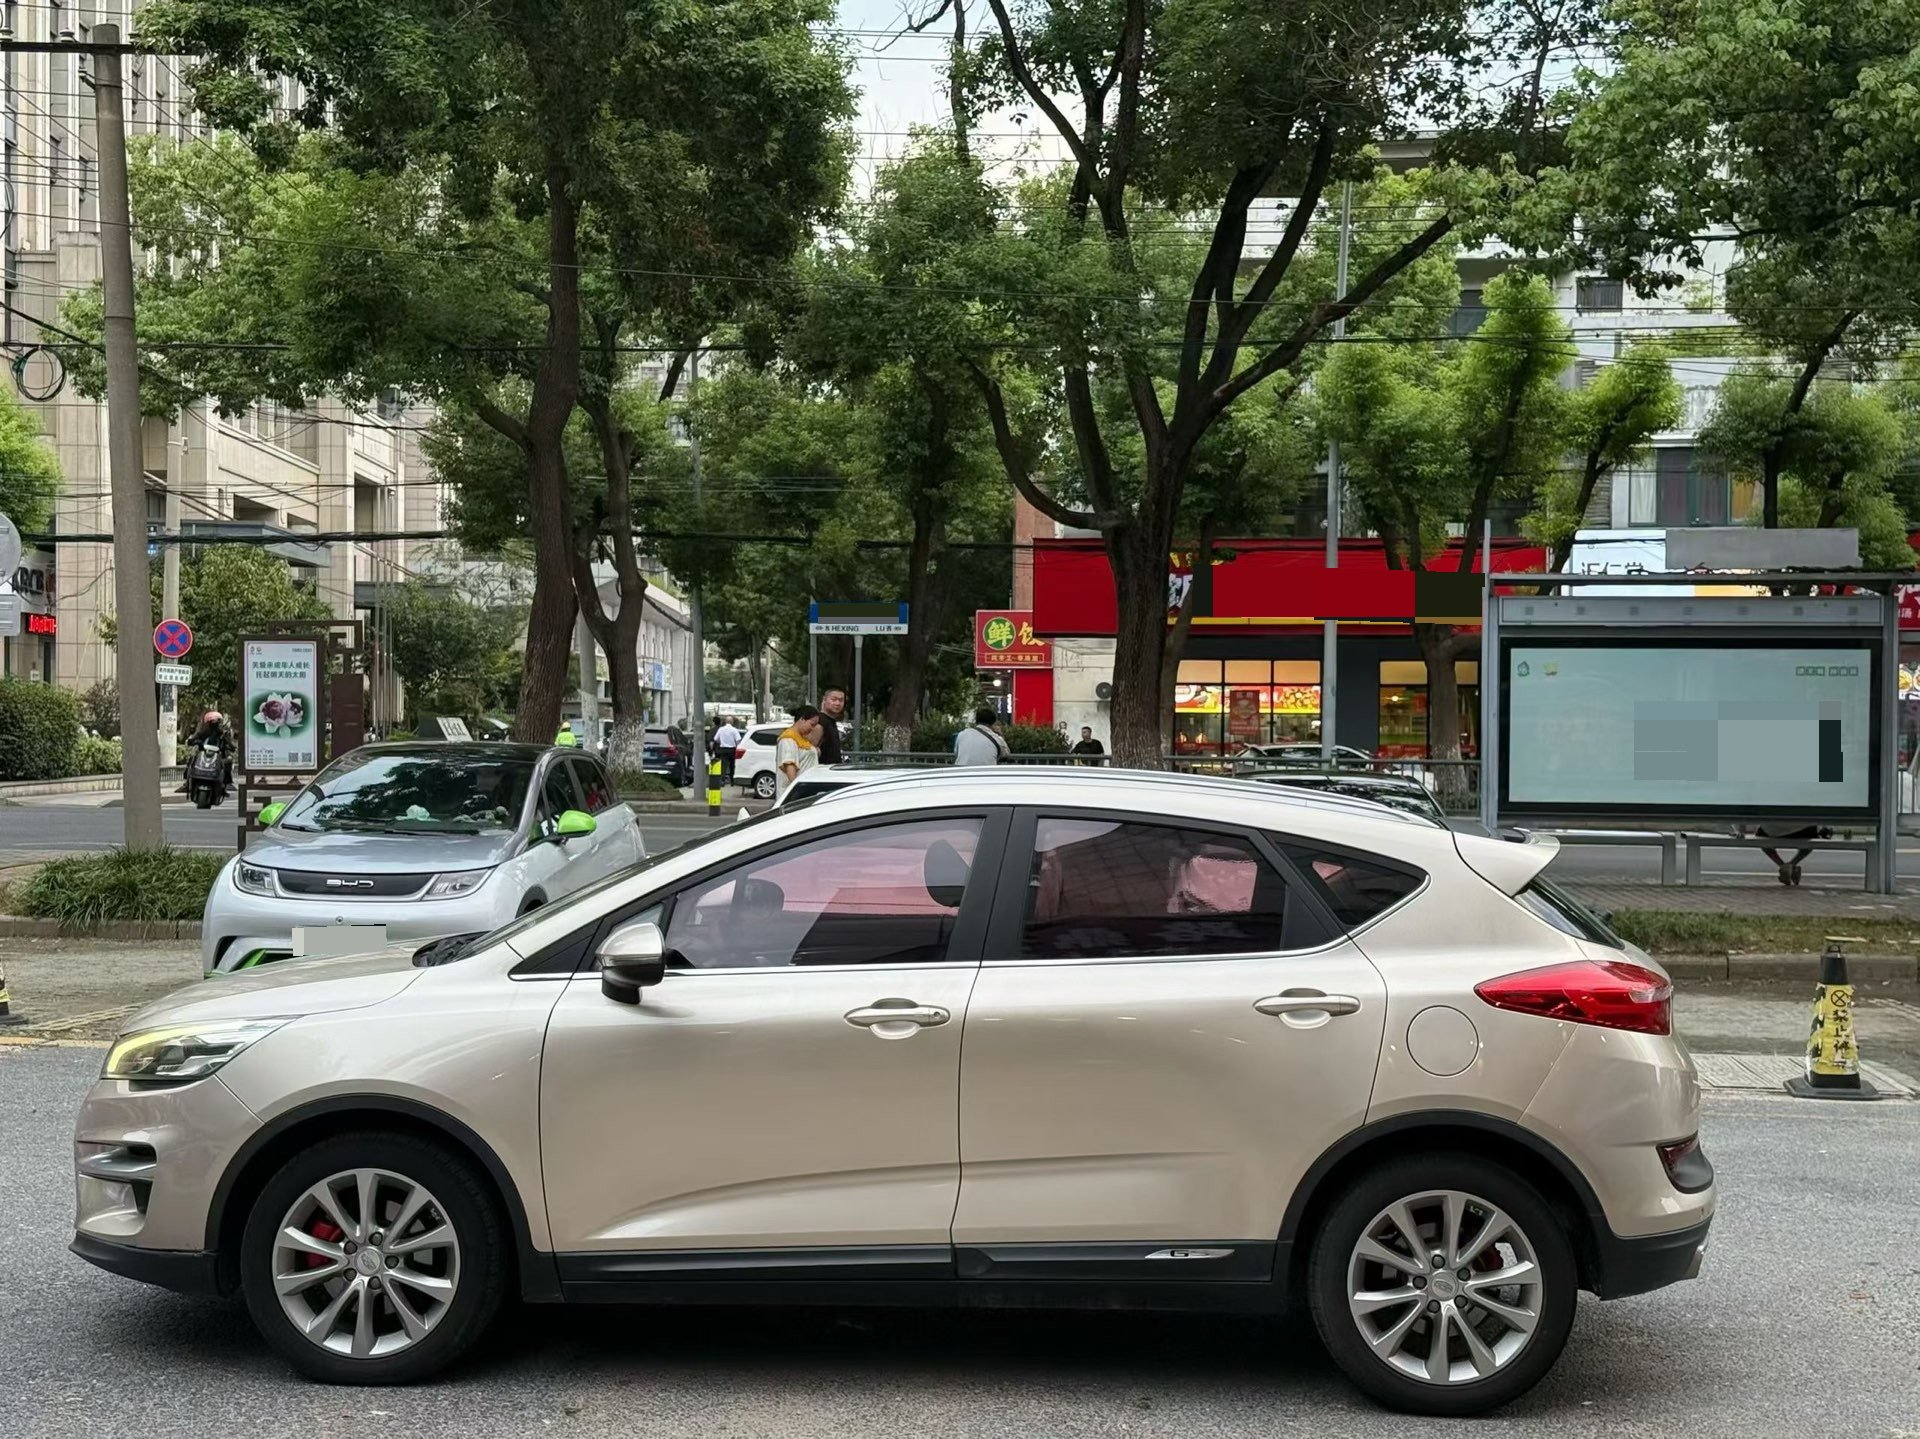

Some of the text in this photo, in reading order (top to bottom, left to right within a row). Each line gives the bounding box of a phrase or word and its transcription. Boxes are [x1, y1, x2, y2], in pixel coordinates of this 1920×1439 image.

[326, 879, 374, 888] BYD
[1832, 1010, 1850, 1069] 禁止停
